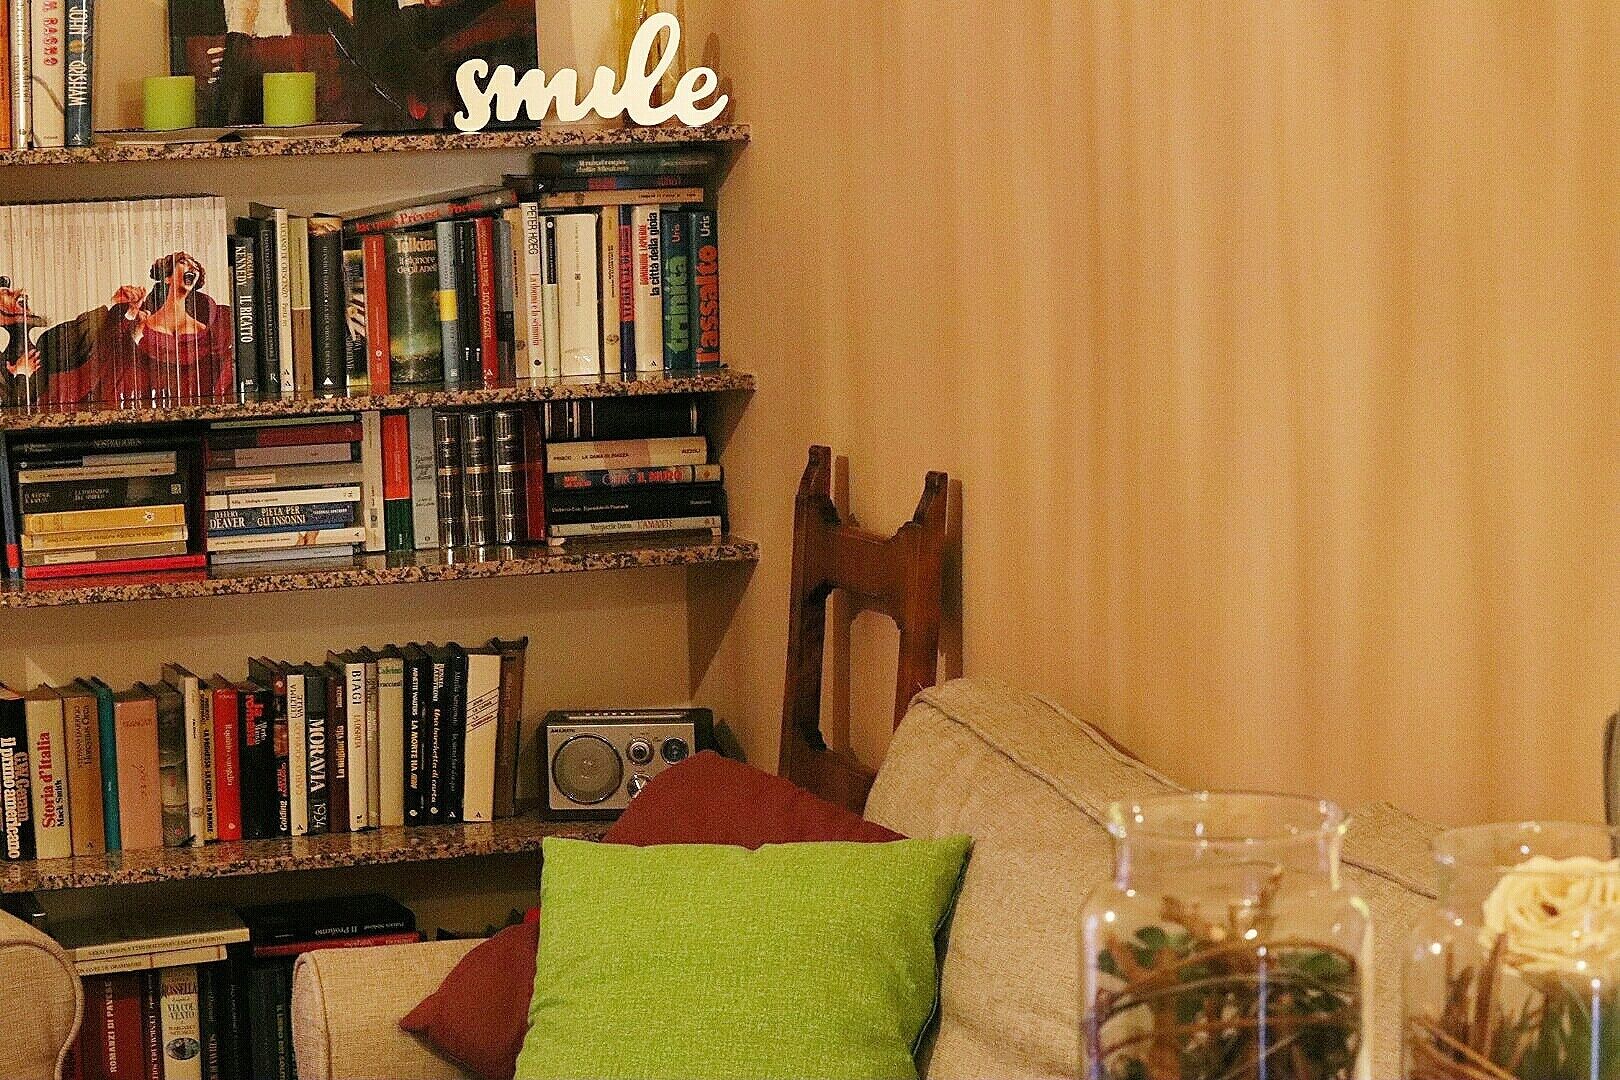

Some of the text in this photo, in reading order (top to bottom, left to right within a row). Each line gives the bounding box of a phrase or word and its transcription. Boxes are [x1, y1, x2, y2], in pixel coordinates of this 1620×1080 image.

[68, 6, 89, 106] JOHN GRISHAM
[454, 12, 729, 132] smile
[527, 205, 538, 230] PETER
[699, 216, 711, 238] Uris
[396, 236, 437, 253] Tolkien
[672, 224, 681, 243] Uris
[235, 246, 247, 286] KENNEDY
[647, 212, 660, 296] la città della gioia
[529, 273, 539, 282] La
[530, 283, 541, 304] donna
[240, 295, 253, 342] IL RICATTO
[530, 318, 542, 346] scimmia
[209, 516, 245, 529] DEAVER
[257, 514, 306, 527] GLI INSONNI
[286, 506, 301, 515] PER
[352, 670, 362, 704] BIAGI
[411, 720, 419, 730] LA
[309, 719, 326, 792] MORAVIA
[410, 760, 418, 772] HA
[36, 732, 56, 828] Storia d'Italia
[336, 768, 345, 779] La
[0, 737, 22, 859] il primo americano
[15, 779, 29, 822] Ceram
[54, 780, 65, 827] Mack Smith
[279, 800, 288, 831] Golding
[313, 803, 327, 828] 1934
[314, 927, 350, 936] Profumo
[167, 1003, 180, 1012] VIA
[169, 1011, 194, 1020] VENTO
[104, 981, 117, 1073] ROMANZI DI PAVESE
